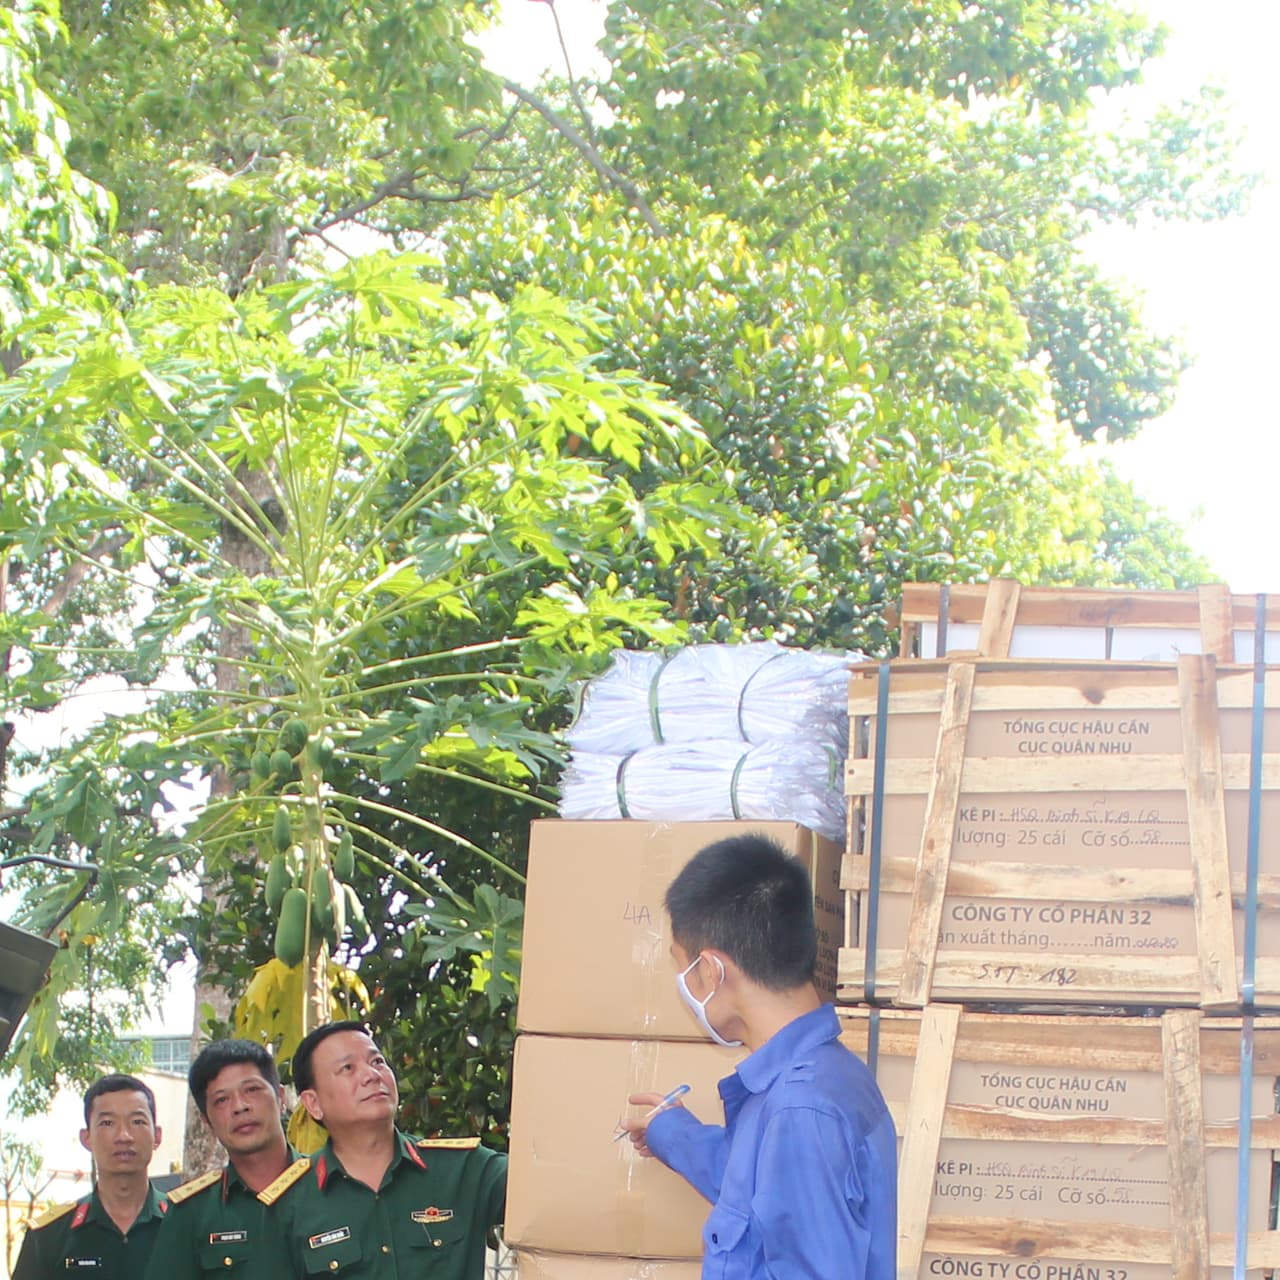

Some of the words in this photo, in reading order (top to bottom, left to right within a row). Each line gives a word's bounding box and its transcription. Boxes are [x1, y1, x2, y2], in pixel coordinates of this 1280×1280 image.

[1003, 716, 1045, 734] TỔNG
[1049, 722, 1078, 738] CỤC
[1082, 719, 1114, 738] HẬU
[1052, 739, 1095, 755] QUÂN
[1099, 742, 1132, 754] NHU
[959, 806, 978, 822] KÊ
[1018, 830, 1037, 845] 25
[1043, 829, 1066, 845] cái
[1081, 829, 1106, 846] Cỡ
[952, 903, 1006, 922] CÔNG
[1011, 907, 1034, 922] TY
[1039, 904, 1065, 923] CỔ
[1129, 910, 1152, 925] 32
[960, 927, 996, 945] xuất
[1038, 967, 1079, 986] 182
[981, 1071, 1021, 1088] TỔNG
[1026, 1076, 1056, 1092] CỤC
[1060, 1076, 1091, 1094] HẬU
[1028, 1094, 1072, 1111] QUÂN
[1076, 1098, 1109, 1112] NHU
[936, 1160, 955, 1174] KÊ
[995, 1185, 1014, 1200] 25
[1019, 1185, 1043, 1201] cái
[1058, 1186, 1083, 1204] Cỡ
[930, 1256, 983, 1277] CÔNG
[988, 1263, 1010, 1280] TY
[1015, 1259, 1041, 1280] CỔ
